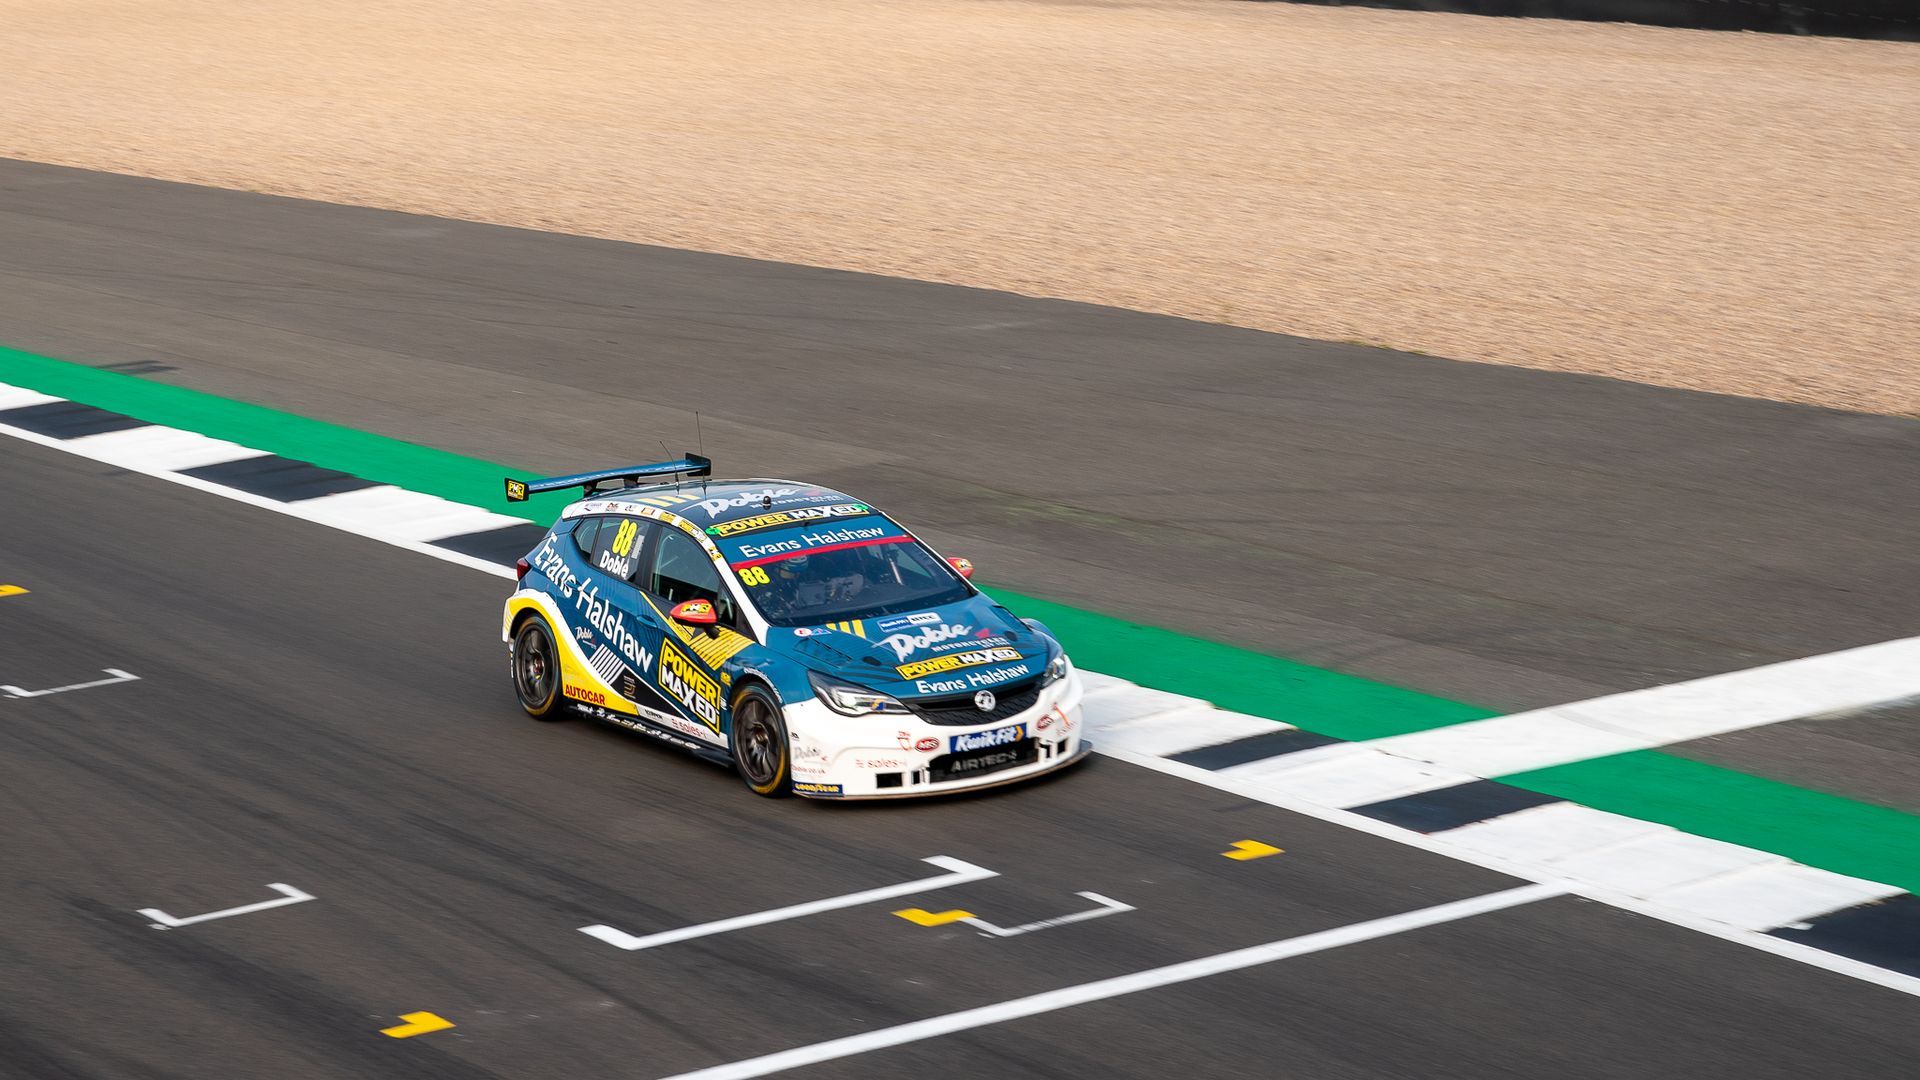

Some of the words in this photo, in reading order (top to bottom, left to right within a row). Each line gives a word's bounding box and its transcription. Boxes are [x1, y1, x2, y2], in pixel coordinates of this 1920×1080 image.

[678, 487, 801, 519] Doble
[718, 512, 790, 535] POWER
[791, 504, 862, 520] MAXED
[612, 518, 638, 558] 88
[738, 539, 802, 558] Evans
[802, 526, 885, 547] Halshaw
[600, 549, 629, 579] Doble
[738, 566, 771, 587] 88
[534, 531, 577, 598] Evans
[577, 577, 654, 673] Halshaw
[872, 623, 973, 664] Doble
[663, 644, 718, 707] POWER
[901, 656, 962, 678] POWER
[958, 649, 1017, 663] MAXED
[915, 678, 968, 694] Evans
[966, 663, 1030, 687] Halshaw
[565, 684, 606, 706] AUTOCAR
[661, 665, 717, 725] MAXED
